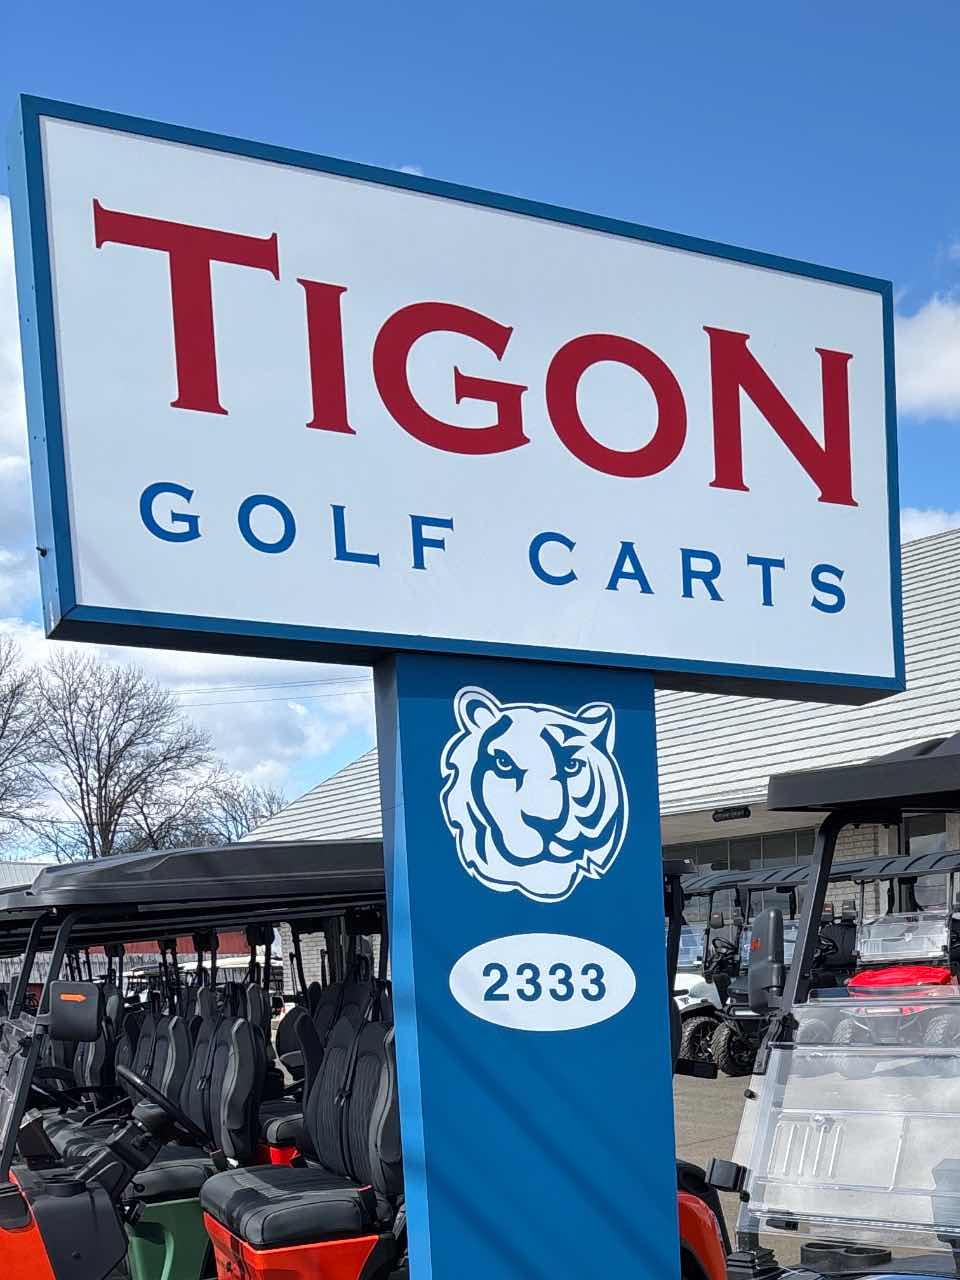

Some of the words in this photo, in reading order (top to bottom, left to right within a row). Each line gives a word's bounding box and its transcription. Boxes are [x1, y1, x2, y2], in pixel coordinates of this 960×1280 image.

[92, 198, 858, 507] TIGON
[139, 481, 455, 571] GOLF
[528, 531, 847, 614] CARTS
[482, 962, 607, 1002] 2333
